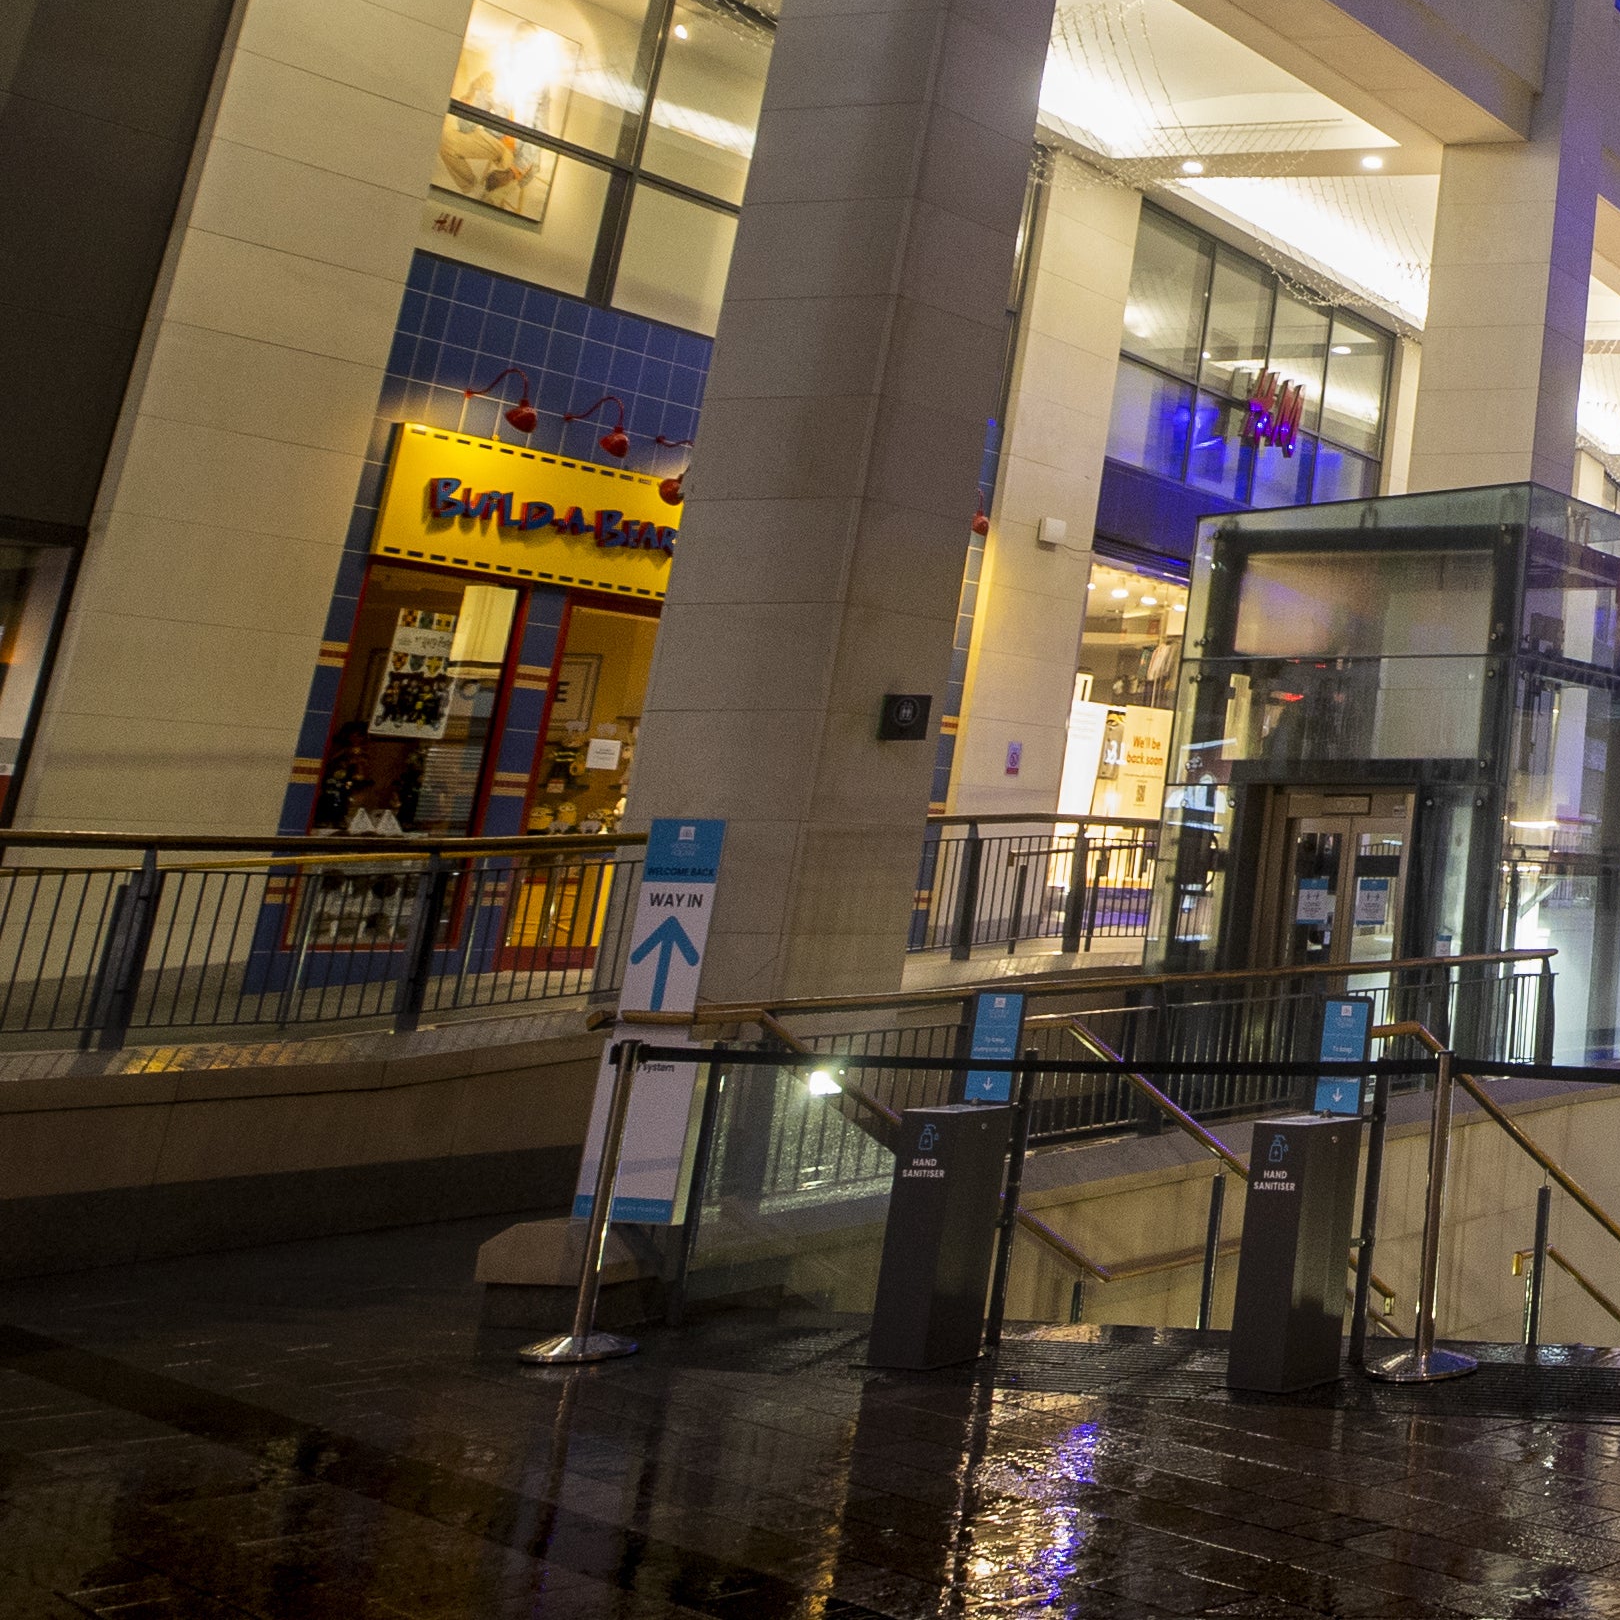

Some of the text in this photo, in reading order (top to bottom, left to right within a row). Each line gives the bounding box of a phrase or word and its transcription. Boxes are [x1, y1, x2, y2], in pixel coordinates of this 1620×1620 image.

[1151, 739, 1161, 750] be
[650, 892, 704, 909] WAY IN
[643, 1063, 675, 1073] system
[912, 1158, 937, 1167] HAND
[902, 1168, 946, 1179] SANITISER
[1263, 1170, 1288, 1179] HAND
[1253, 1181, 1296, 1192] SANITISER
